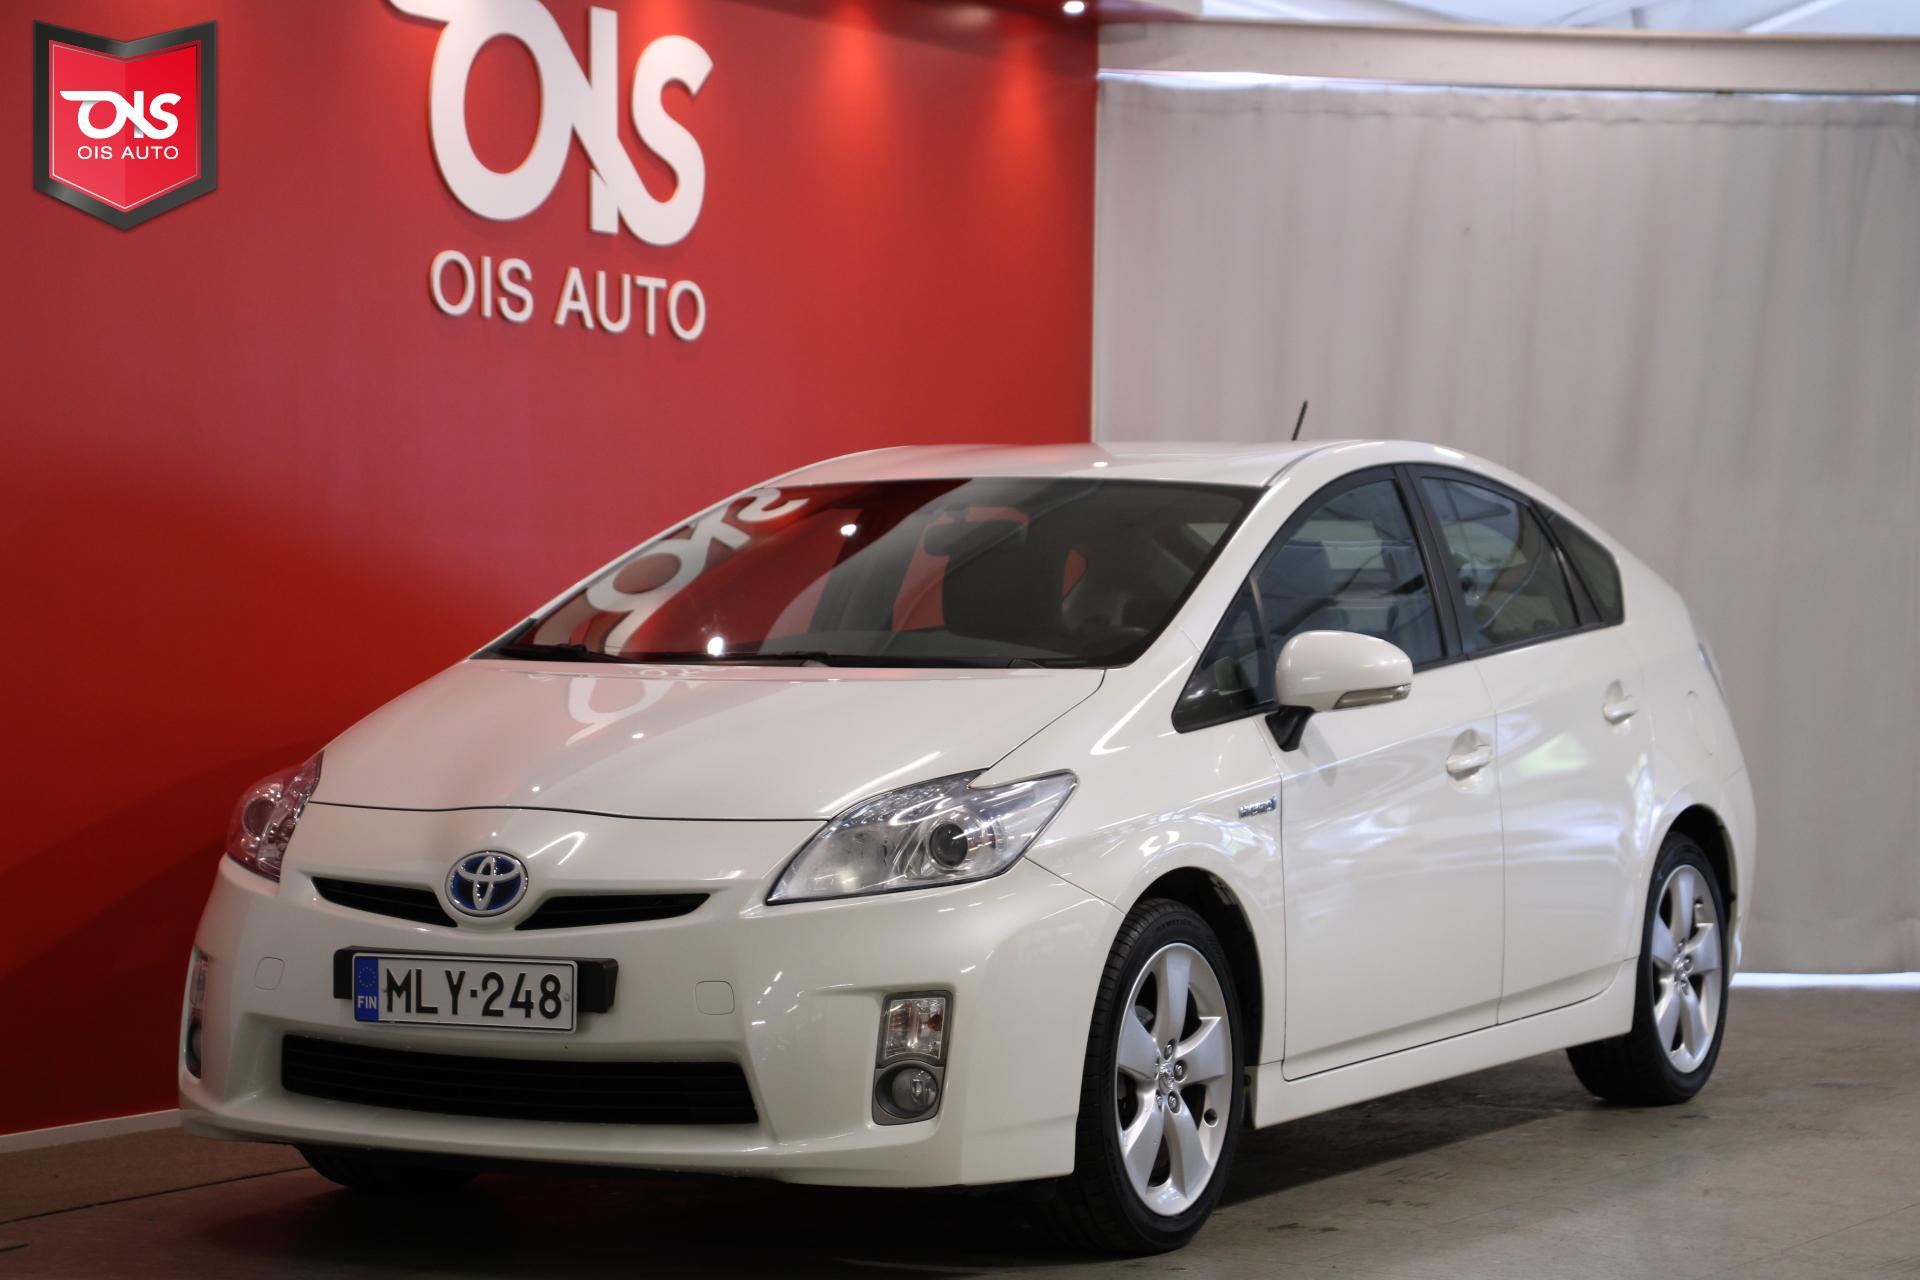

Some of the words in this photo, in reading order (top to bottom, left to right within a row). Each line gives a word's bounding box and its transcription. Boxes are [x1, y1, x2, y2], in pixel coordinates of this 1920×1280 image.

[388, 0, 714, 246] OIS
[430, 249, 534, 323] OIS
[554, 266, 707, 341] AUTO
[357, 995, 377, 1010] FIN
[386, 967, 562, 1020] MLY-248
